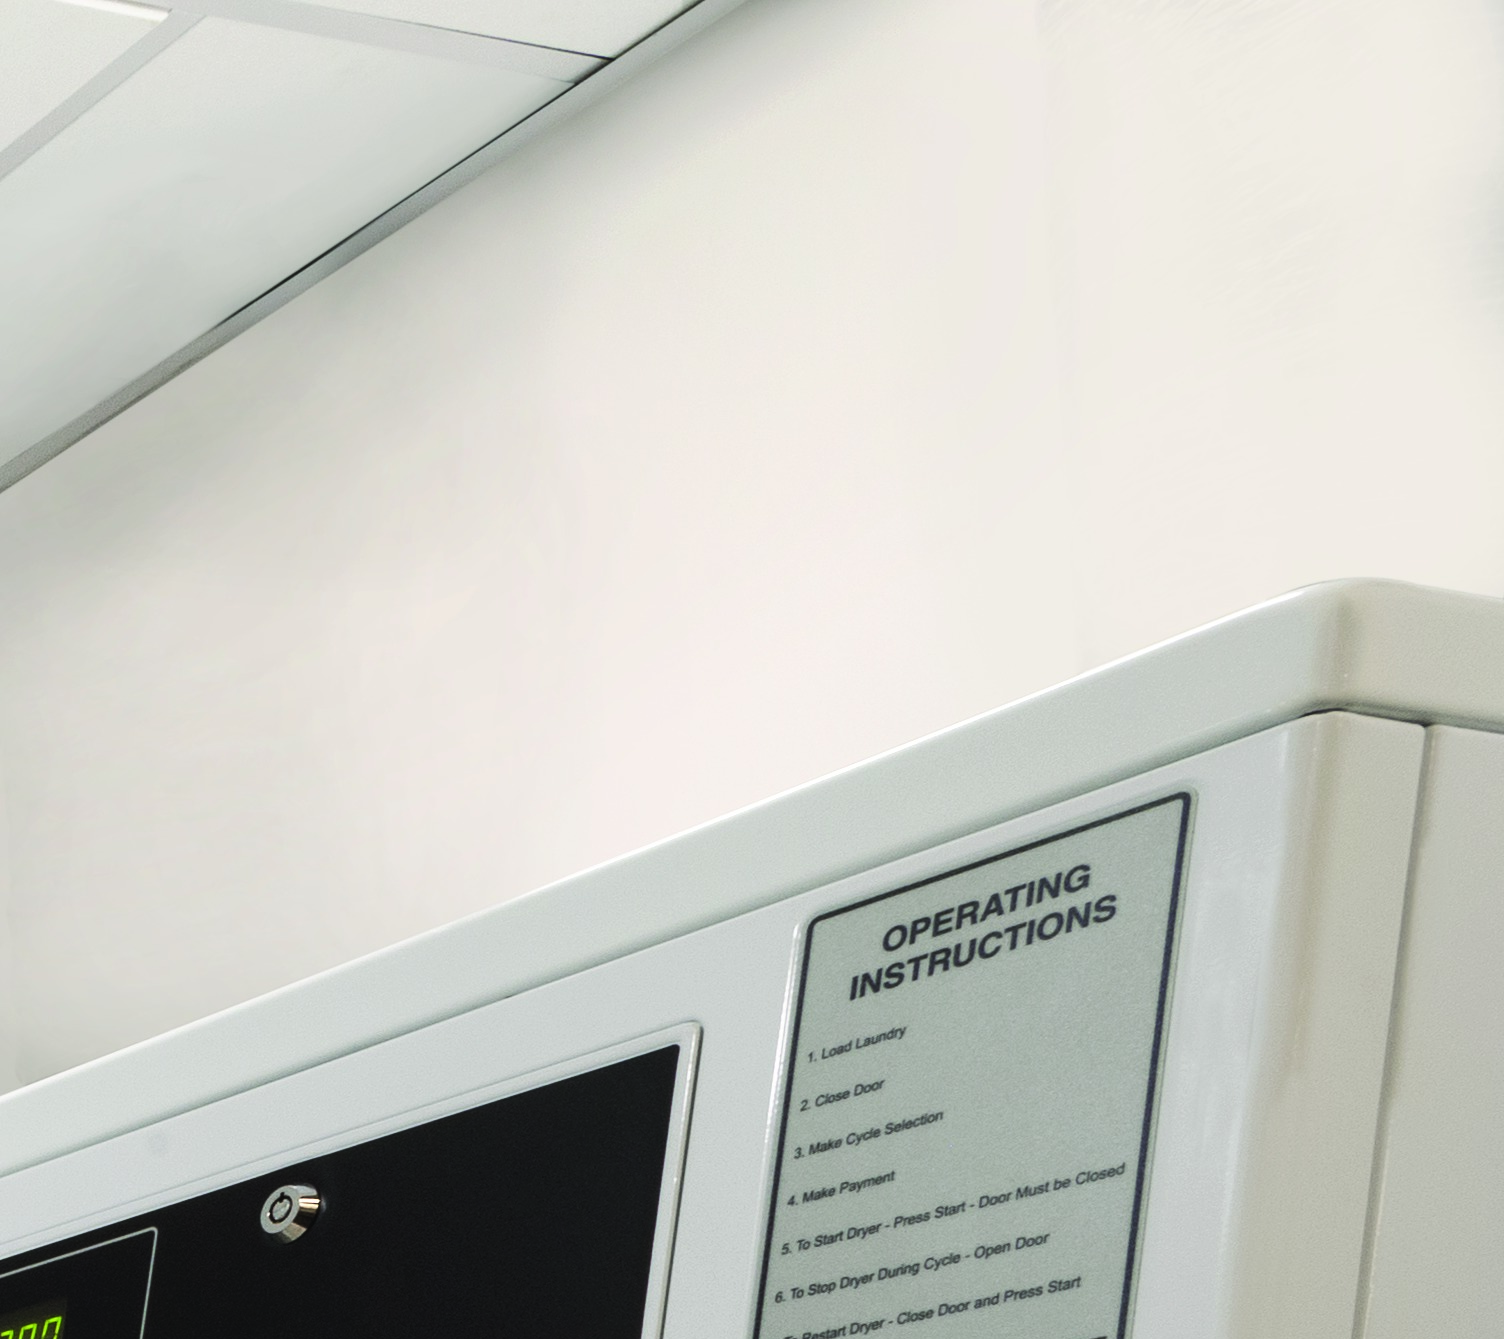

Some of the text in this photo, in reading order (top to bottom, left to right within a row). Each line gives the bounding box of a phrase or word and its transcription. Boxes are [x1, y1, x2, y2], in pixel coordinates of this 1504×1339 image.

[881, 863, 1090, 952] OPERATING
[849, 894, 1117, 1001] INSTRUCTIONS
[808, 1026, 907, 1062] 1. Load Laundry
[800, 1079, 885, 1111] 2. Close Door
[794, 1111, 944, 1159] 3. Make Cycle Selection
[781, 1242, 791, 1254] 5.
[796, 1238, 811, 1251] To
[813, 1230, 844, 1247] Start
[846, 1222, 882, 1240] Dryer
[892, 1211, 930, 1228] Press
[933, 1201, 966, 1219] Start
[978, 1191, 1012, 1208] Door
[1014, 1181, 1050, 1200] Must
[1052, 1177, 1071, 1191] be
[1074, 1162, 1125, 1185] Closed
[786, 1170, 895, 1206] 4. Make Payment
[774, 1290, 785, 1303] 6.
[790, 1286, 805, 1299] To
[807, 1281, 837, 1296] Stop
[839, 1272, 875, 1289] Dryer
[877, 1262, 920, 1281] During
[922, 1252, 961, 1271] Cycle
[973, 1242, 1011, 1259] Open
[1014, 1233, 1050, 1250] Door
[848, 1318, 885, 1335] Dryer
[896, 1308, 935, 1325] Close
[937, 1300, 971, 1316] Door
[973, 1292, 1000, 1309] and
[1002, 1285, 1043, 1302] Press
[1046, 1275, 1081, 1293] Start
